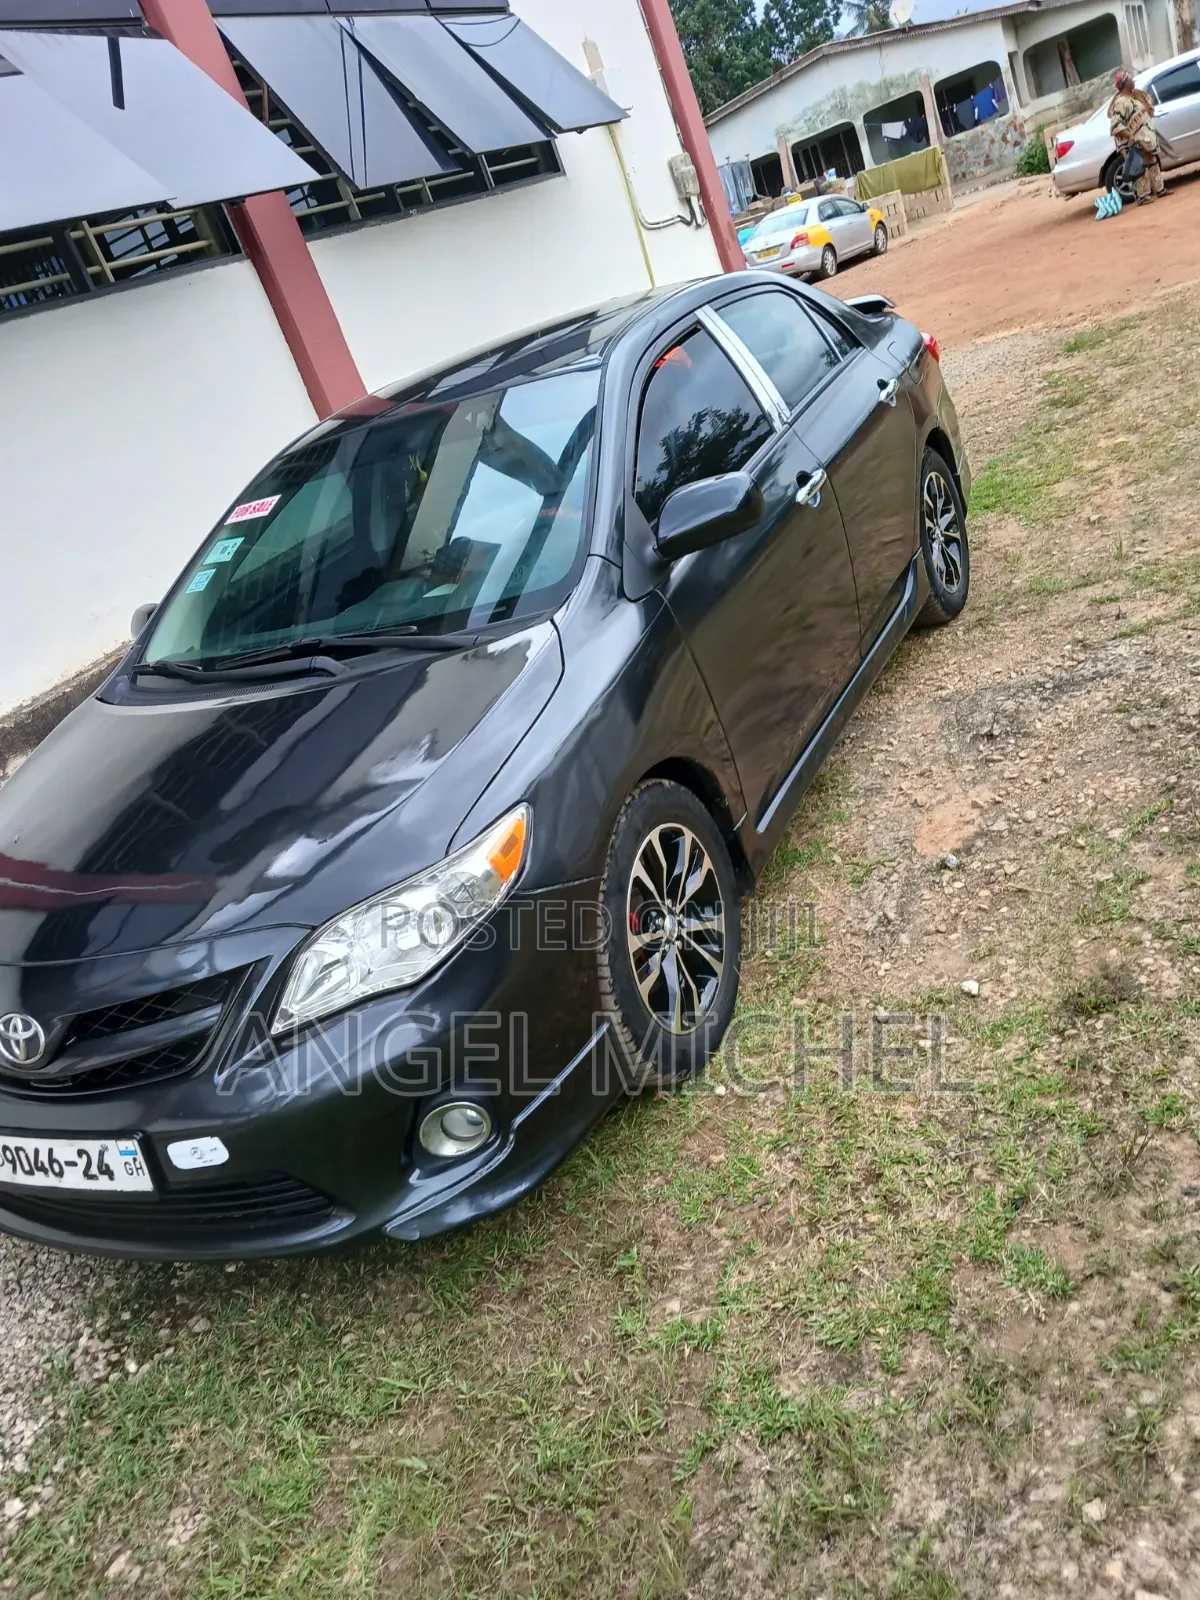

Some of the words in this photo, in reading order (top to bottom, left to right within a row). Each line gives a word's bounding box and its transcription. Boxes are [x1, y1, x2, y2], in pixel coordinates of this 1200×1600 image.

[230, 505, 252, 520] FOR
[249, 499, 276, 515] SALE
[1, 1143, 115, 1182] 9046-24
